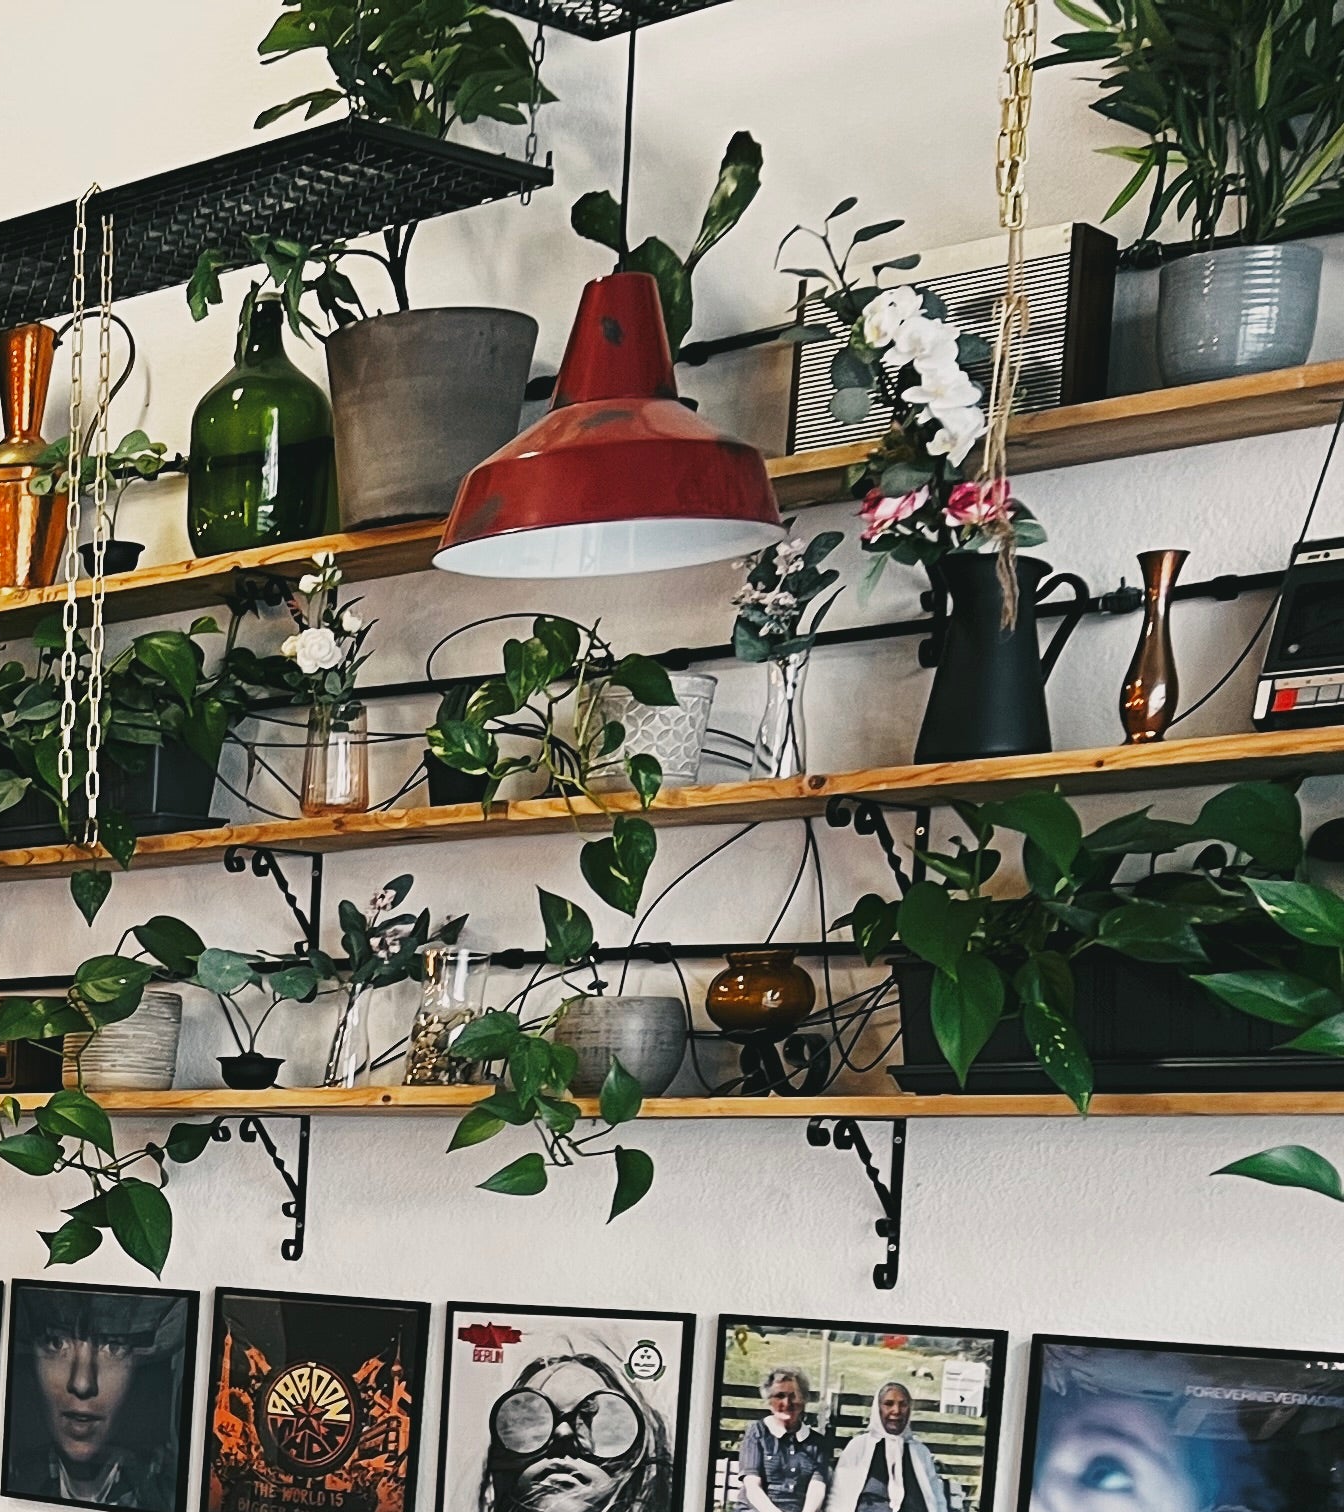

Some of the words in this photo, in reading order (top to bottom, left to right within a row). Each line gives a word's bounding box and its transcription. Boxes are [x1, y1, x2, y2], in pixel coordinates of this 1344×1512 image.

[472, 1349, 504, 1363] BERLIN
[267, 1367, 351, 1422] BABOON
[254, 1480, 277, 1499] THE
[282, 1487, 326, 1506] WORLD
[330, 1492, 344, 1508] IS
